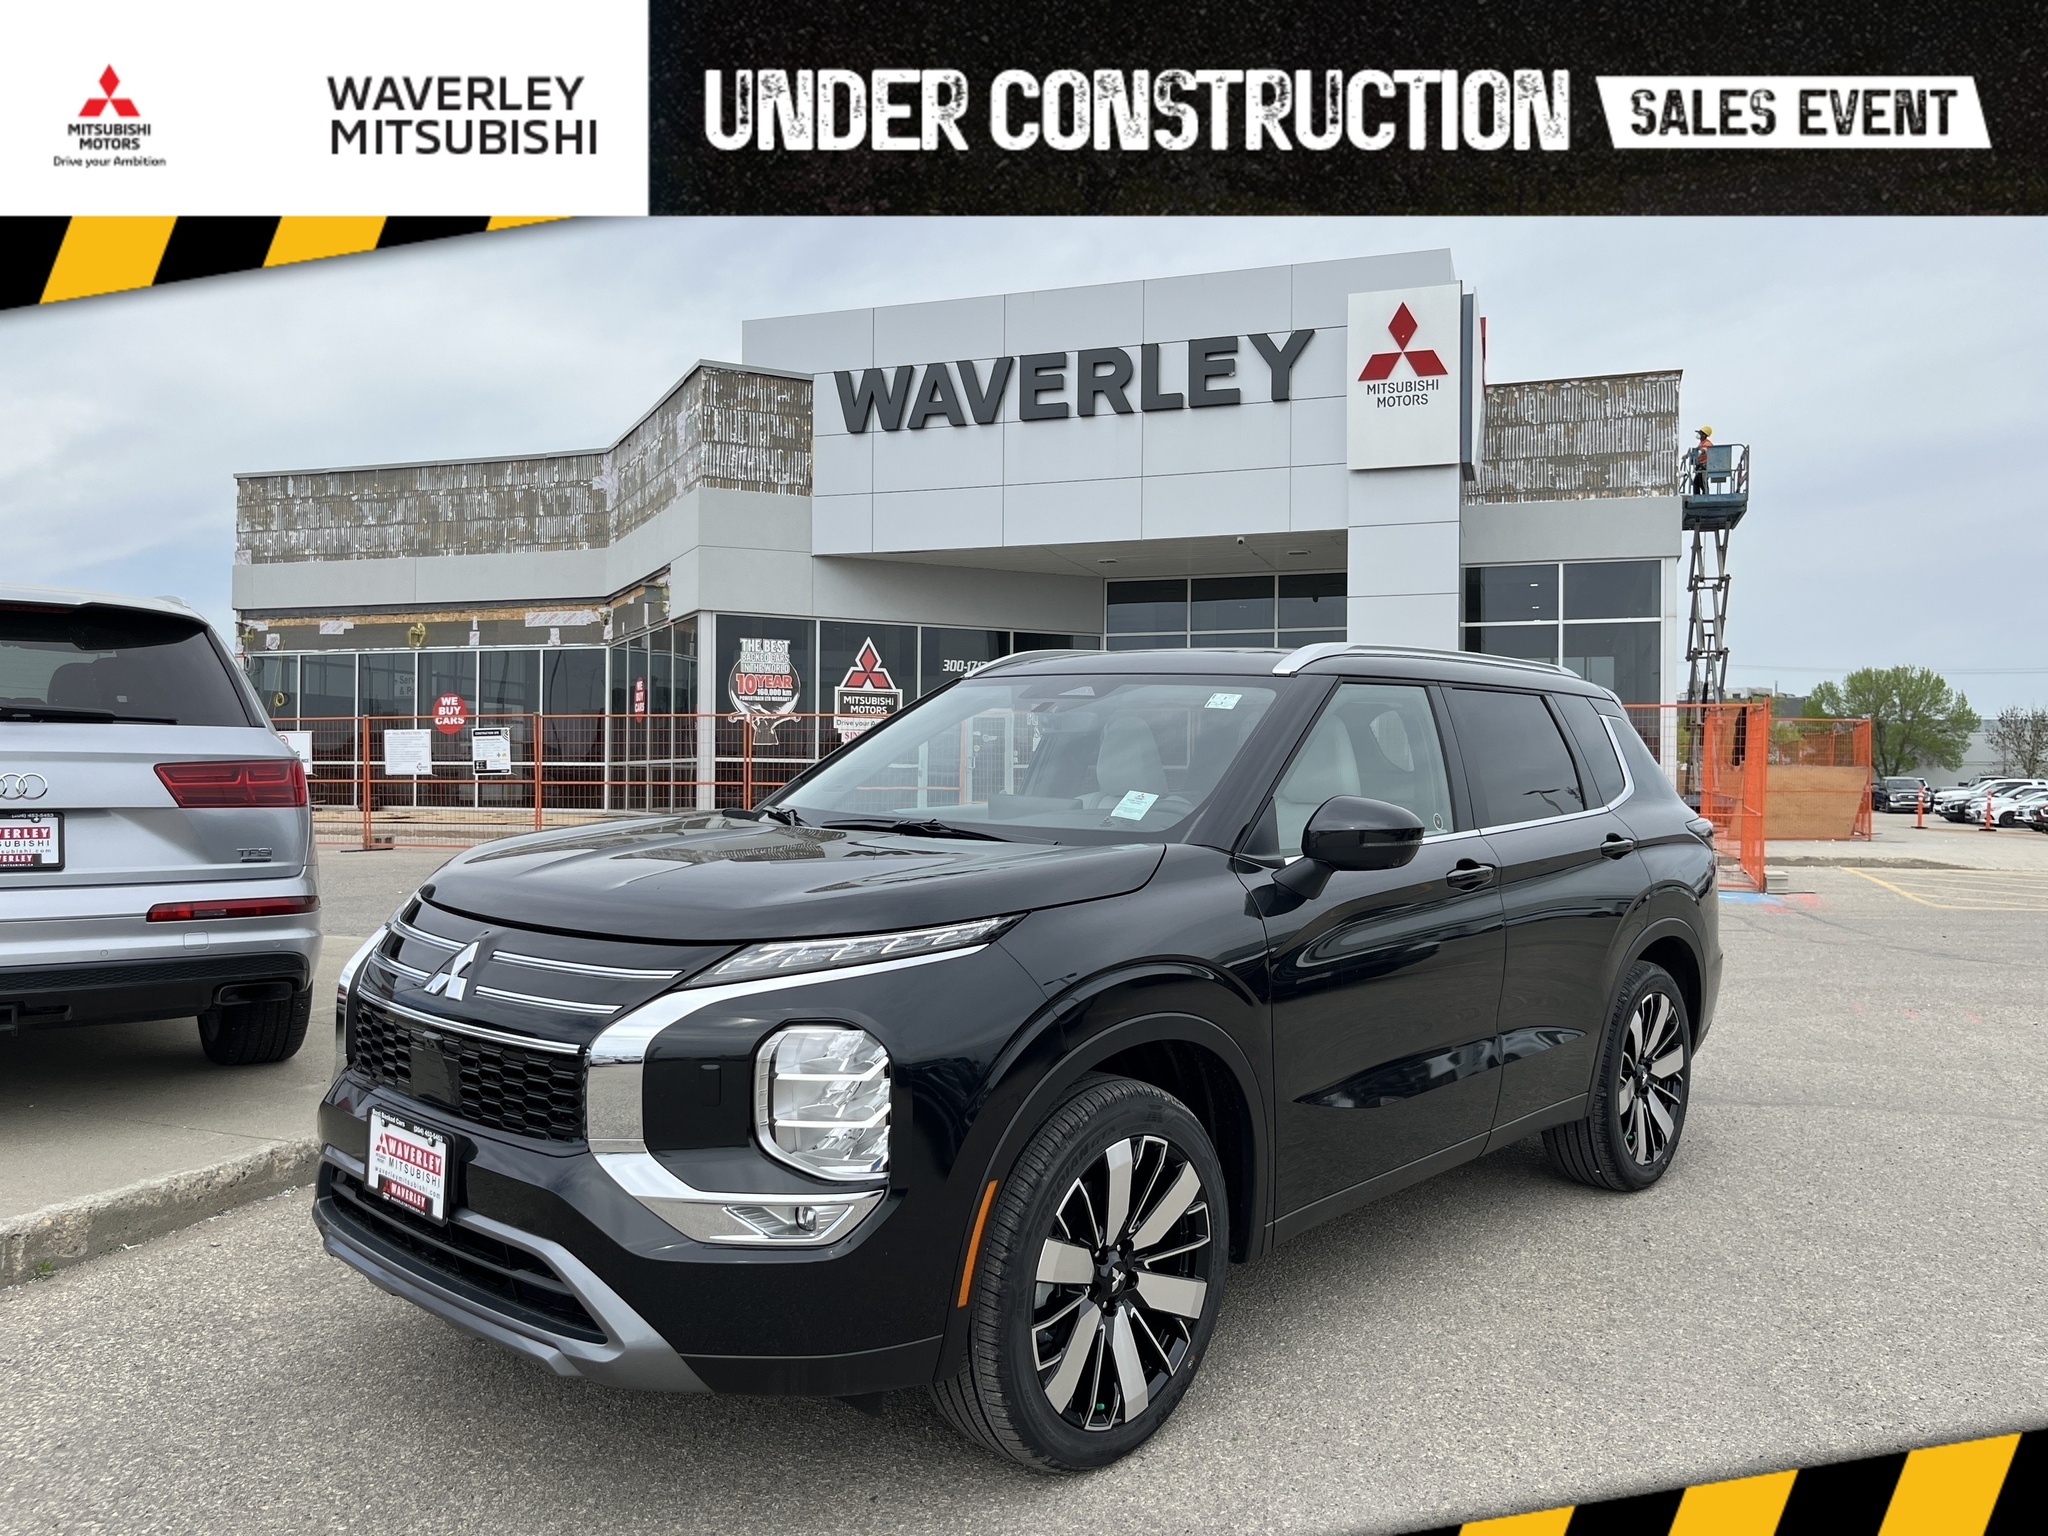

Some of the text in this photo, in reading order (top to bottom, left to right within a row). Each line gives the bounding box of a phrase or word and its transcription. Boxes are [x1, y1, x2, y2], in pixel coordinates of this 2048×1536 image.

[833, 328, 1316, 434] WAVERLEY
[1366, 378, 1439, 396] MITSUBISHI
[1376, 393, 1430, 409] MOTORS
[740, 638, 791, 654] THE BEST
[741, 652, 790, 663] BACKED CARS
[764, 663, 790, 674] WORLD
[736, 673, 793, 695] 10 YEAR
[441, 697, 458, 706] WE
[843, 695, 894, 706] MITSUBISHI
[438, 706, 461, 715] BUY
[850, 705, 888, 715] MOTORS
[435, 716, 464, 725] CARS
[0, 828, 49, 839] ERLEY
[388, 1137, 441, 1174] WAVERLEY
[388, 1157, 441, 1188] MITSUBISHI
[391, 1182, 426, 1208] WAVERLEY
